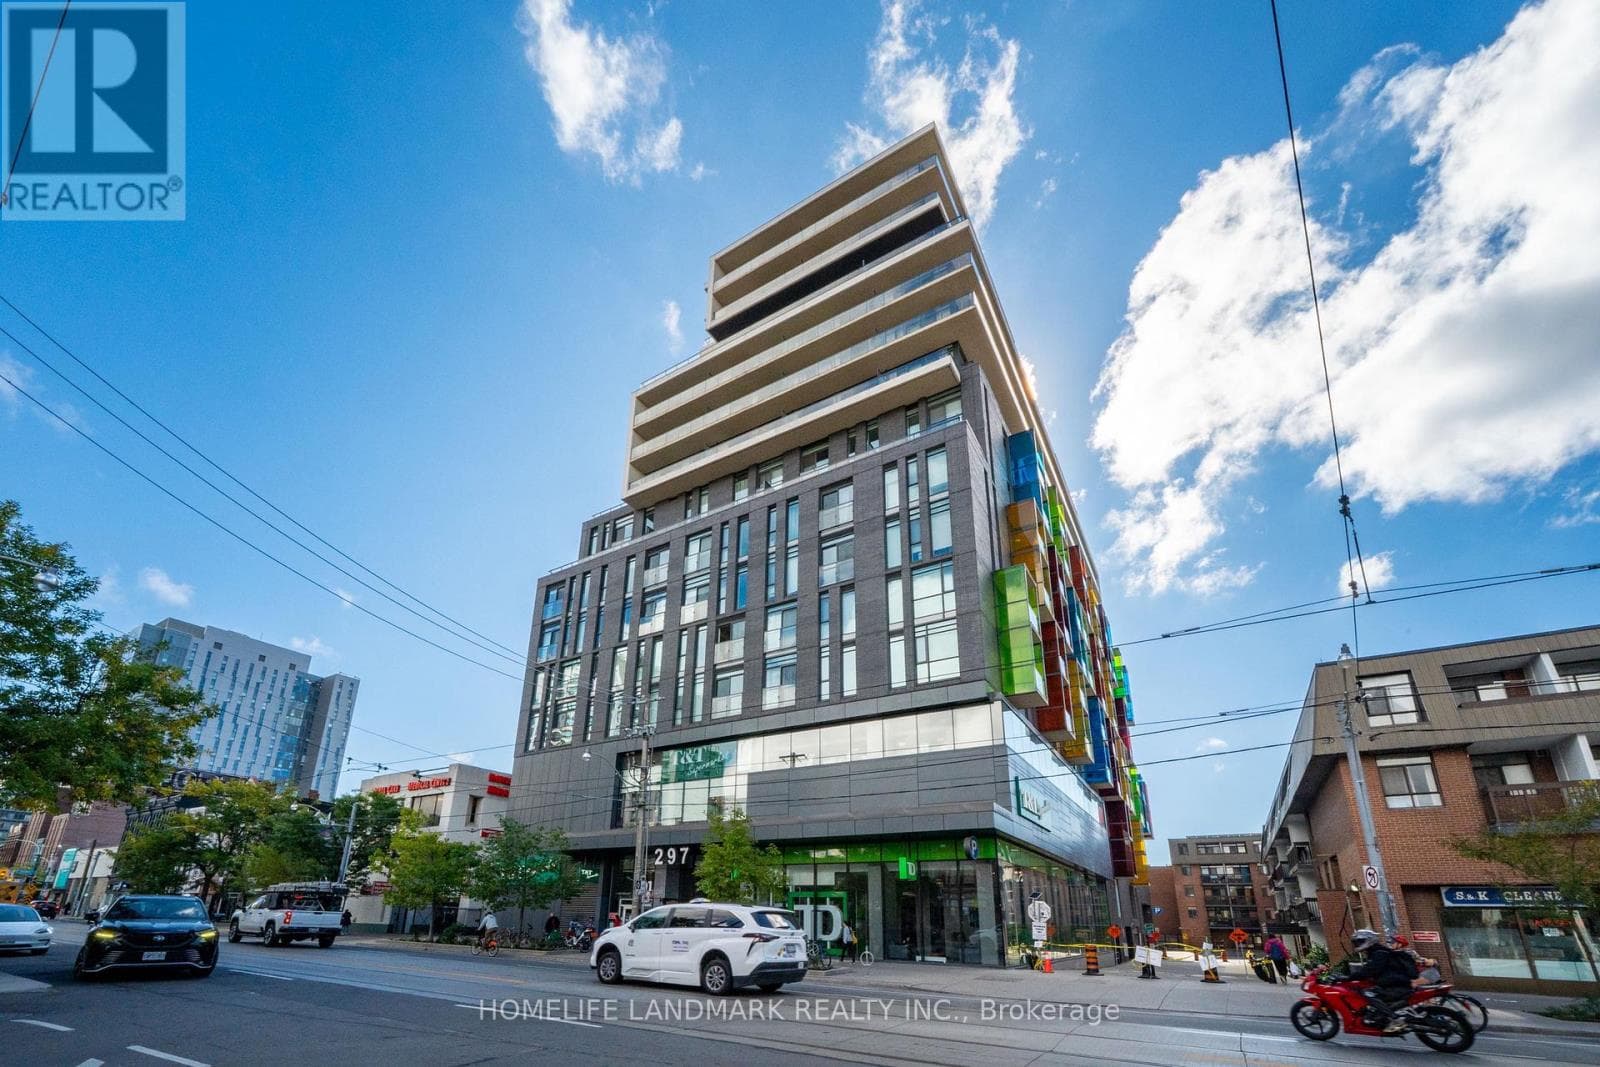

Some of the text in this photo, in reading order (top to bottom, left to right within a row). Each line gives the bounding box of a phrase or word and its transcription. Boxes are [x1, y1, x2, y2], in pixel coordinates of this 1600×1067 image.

[654, 846, 689, 865] 297
[1503, 890, 1572, 903] CLEANE
[793, 897, 843, 949] TD
